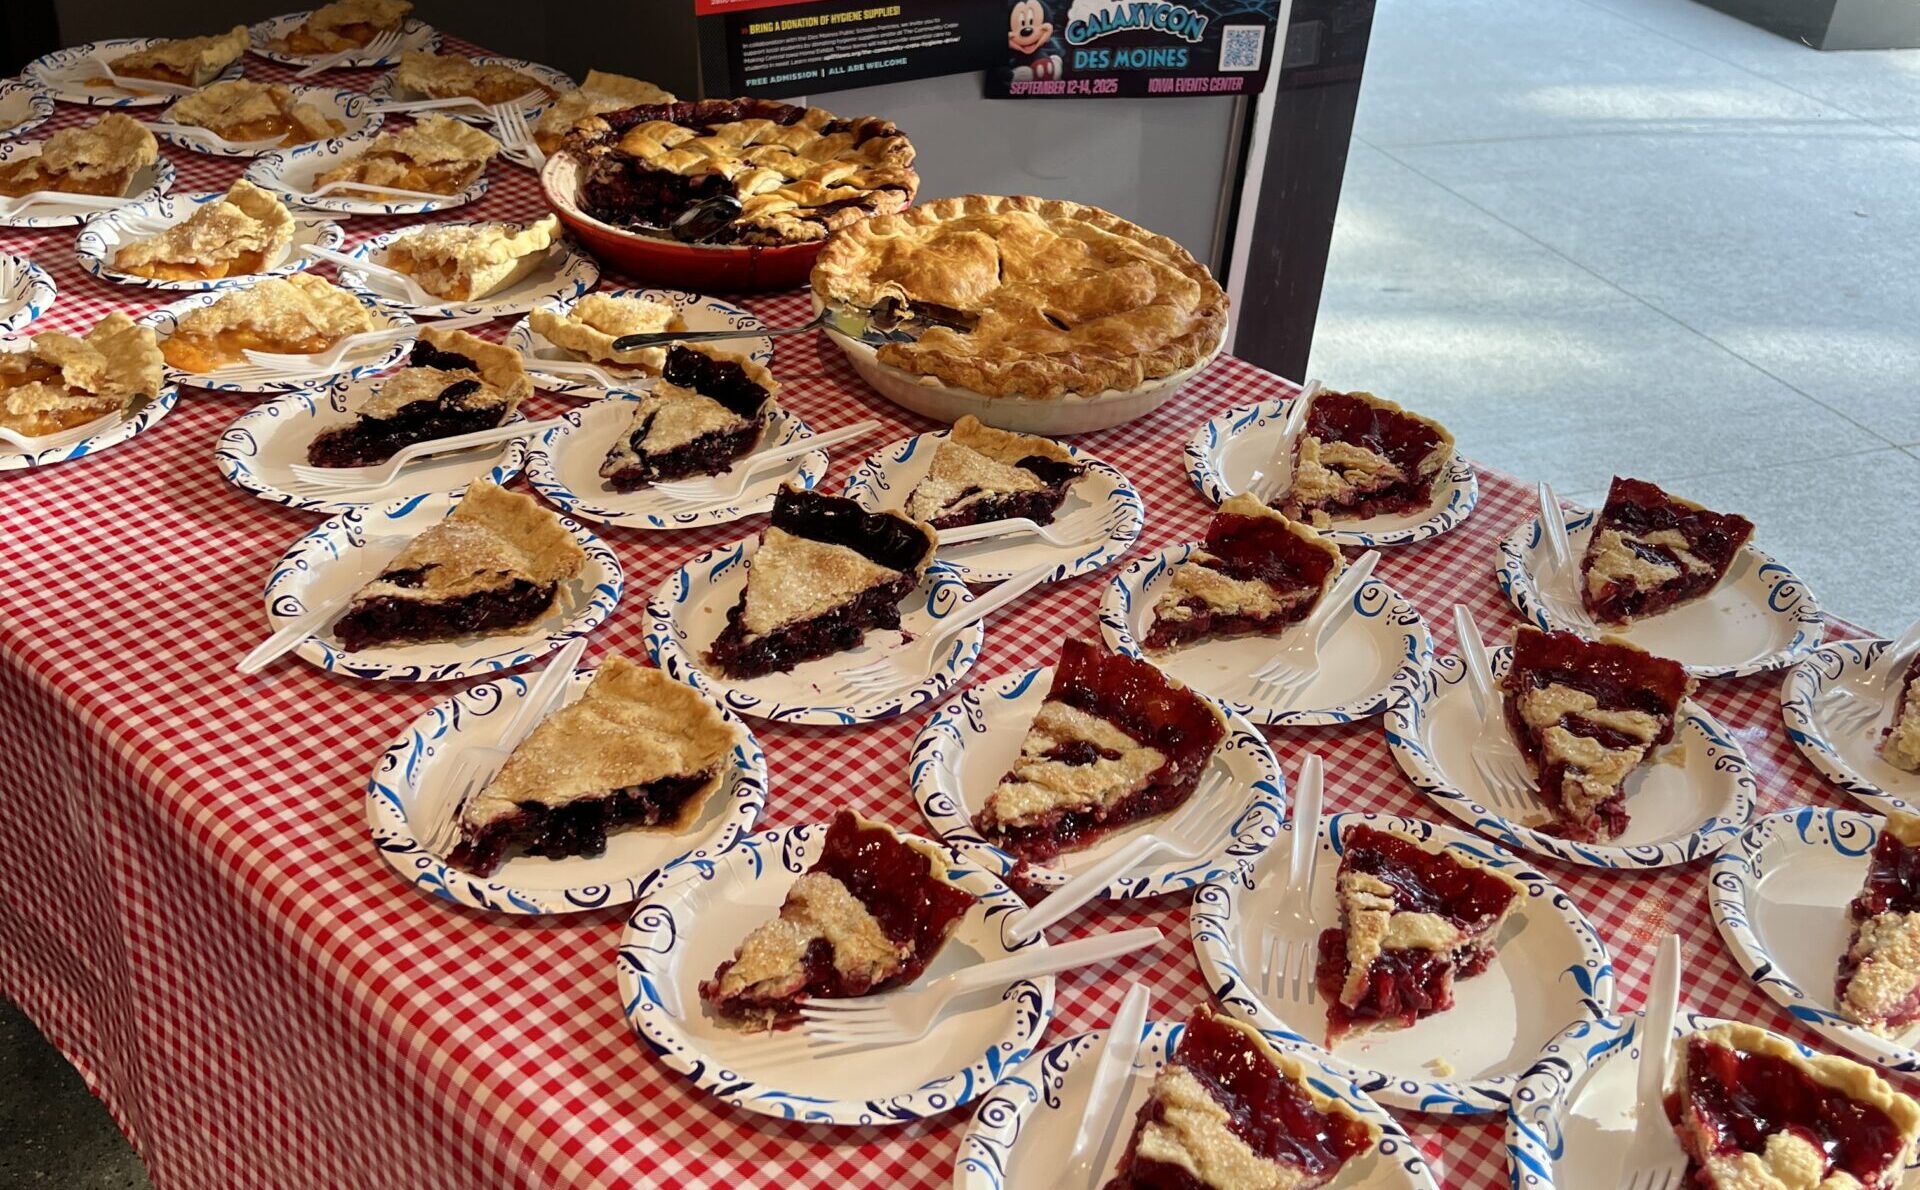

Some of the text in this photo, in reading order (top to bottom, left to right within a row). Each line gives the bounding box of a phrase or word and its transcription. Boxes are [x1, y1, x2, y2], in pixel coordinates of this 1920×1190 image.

[749, 5, 901, 35] BRING A DONATION OF HYGIENE SUPPLIES!
[1066, 3, 1206, 43] GALAXYCON
[1074, 47, 1189, 69] DES MOINES
[745, 57, 908, 87] FREE ADMISSION ALL ARE WELCOME
[1148, 76, 1244, 93] IOWA EVENTS CENTER
[1009, 78, 1119, 95] SEPTEMBER 12-14, 2025
